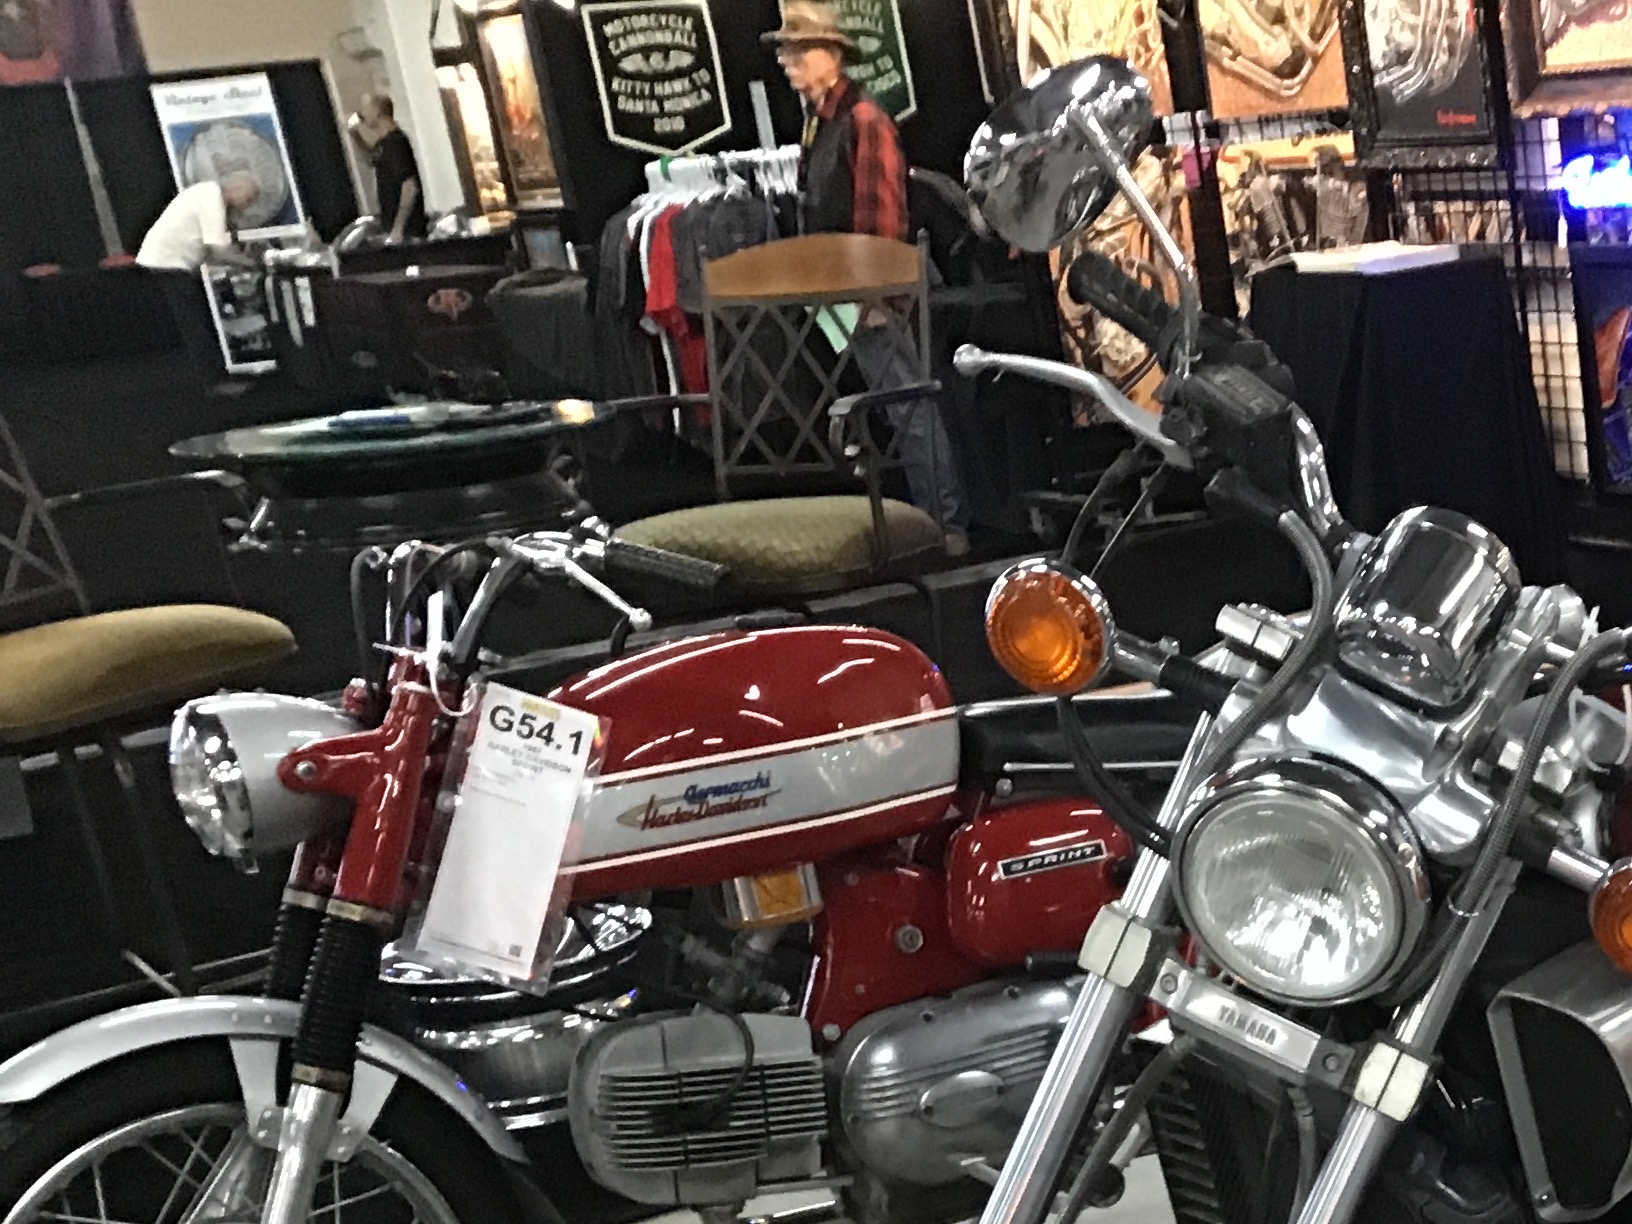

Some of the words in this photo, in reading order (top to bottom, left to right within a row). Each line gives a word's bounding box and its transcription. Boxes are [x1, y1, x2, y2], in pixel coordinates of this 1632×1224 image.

[602, 13, 694, 37] MOTORCYCLE
[608, 29, 697, 56] CANNONBALL
[611, 76, 650, 96] KITTY
[654, 77, 692, 96] HAWK
[692, 67, 711, 86] TO
[617, 95, 660, 113] SANTA
[663, 88, 712, 113] MONICA
[489, 704, 583, 755] G54.1
[1009, 846, 1096, 872] SPRINT
[1218, 1004, 1278, 1046] YAMAHA
